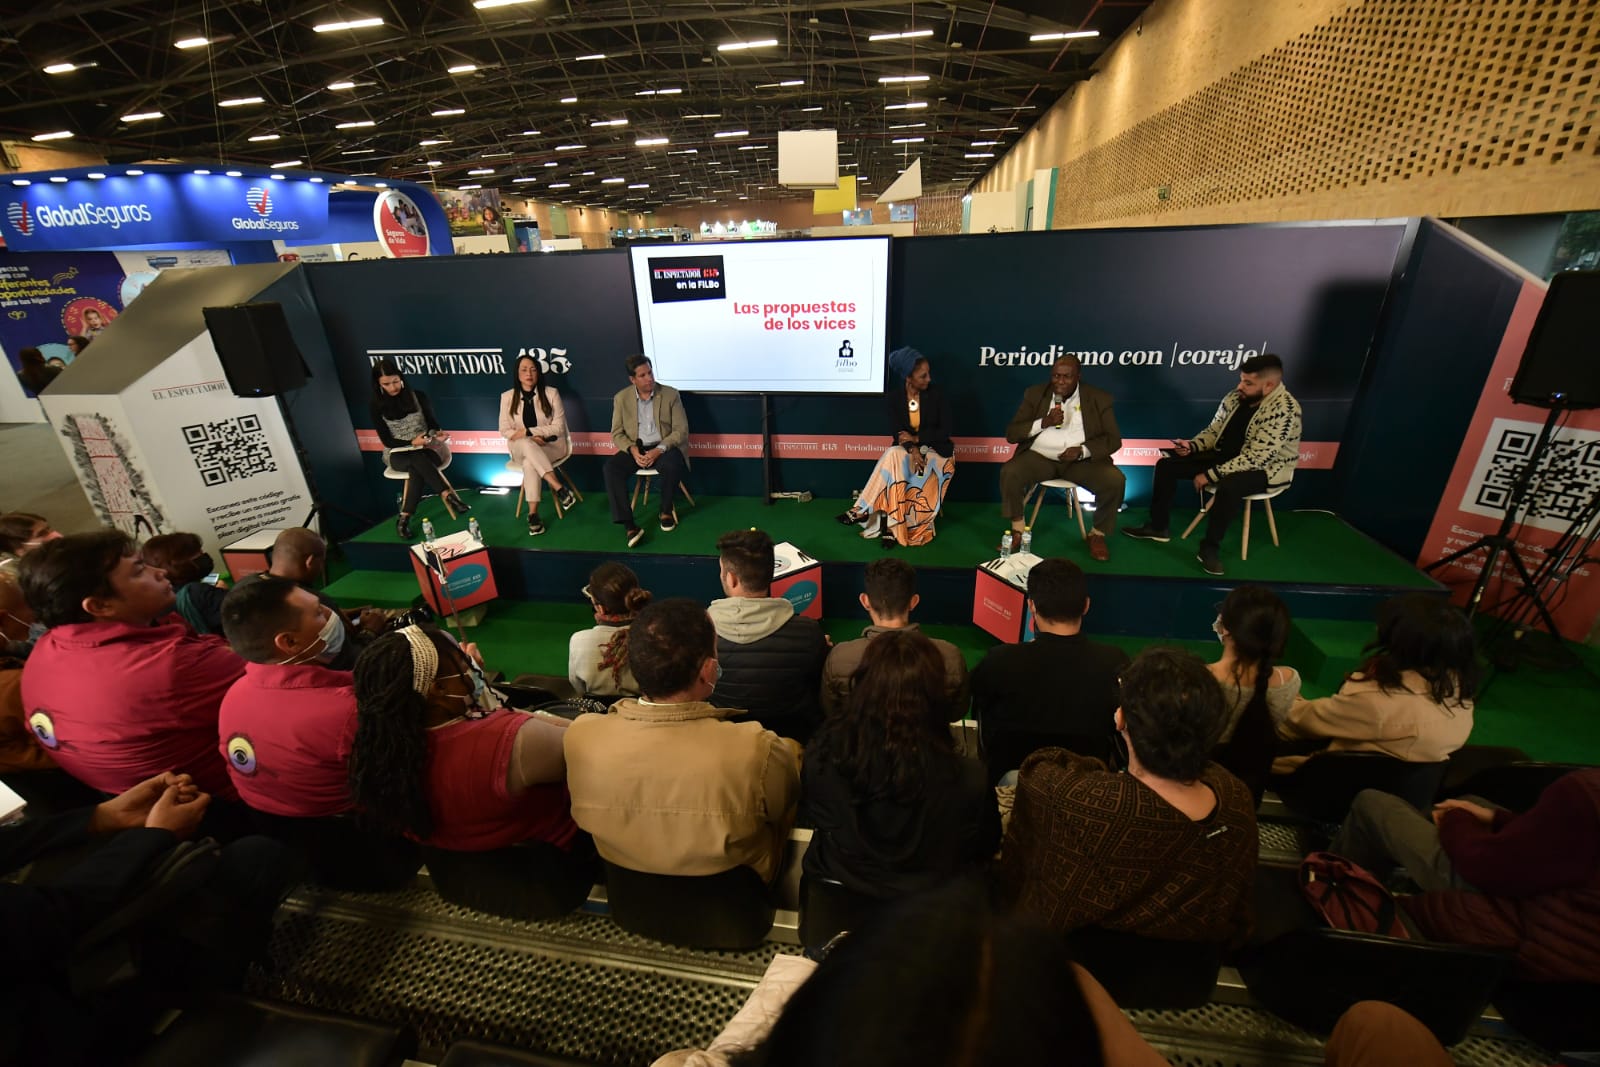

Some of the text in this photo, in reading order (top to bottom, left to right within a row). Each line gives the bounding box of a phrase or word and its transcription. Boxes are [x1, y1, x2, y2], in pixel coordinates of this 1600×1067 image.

[35, 202, 152, 230] GlobalSeguros
[231, 217, 300, 232] GlobalSeguros
[663, 269, 701, 279] ESPECTADOR
[0, 278, 51, 290] iferentes
[676, 281, 687, 290] en
[688, 280, 697, 289] la
[733, 300, 856, 319] Las propuestas
[764, 316, 856, 330] de los vices
[395, 354, 507, 375] ESPECTADOR
[1118, 350, 1164, 366] con
[168, 382, 228, 398] ESPECTADOR
[206, 500, 241, 514] Escanea
[242, 506, 252, 514] un
[240, 515, 256, 523] mes
[1451, 524, 1485, 538] Escan
